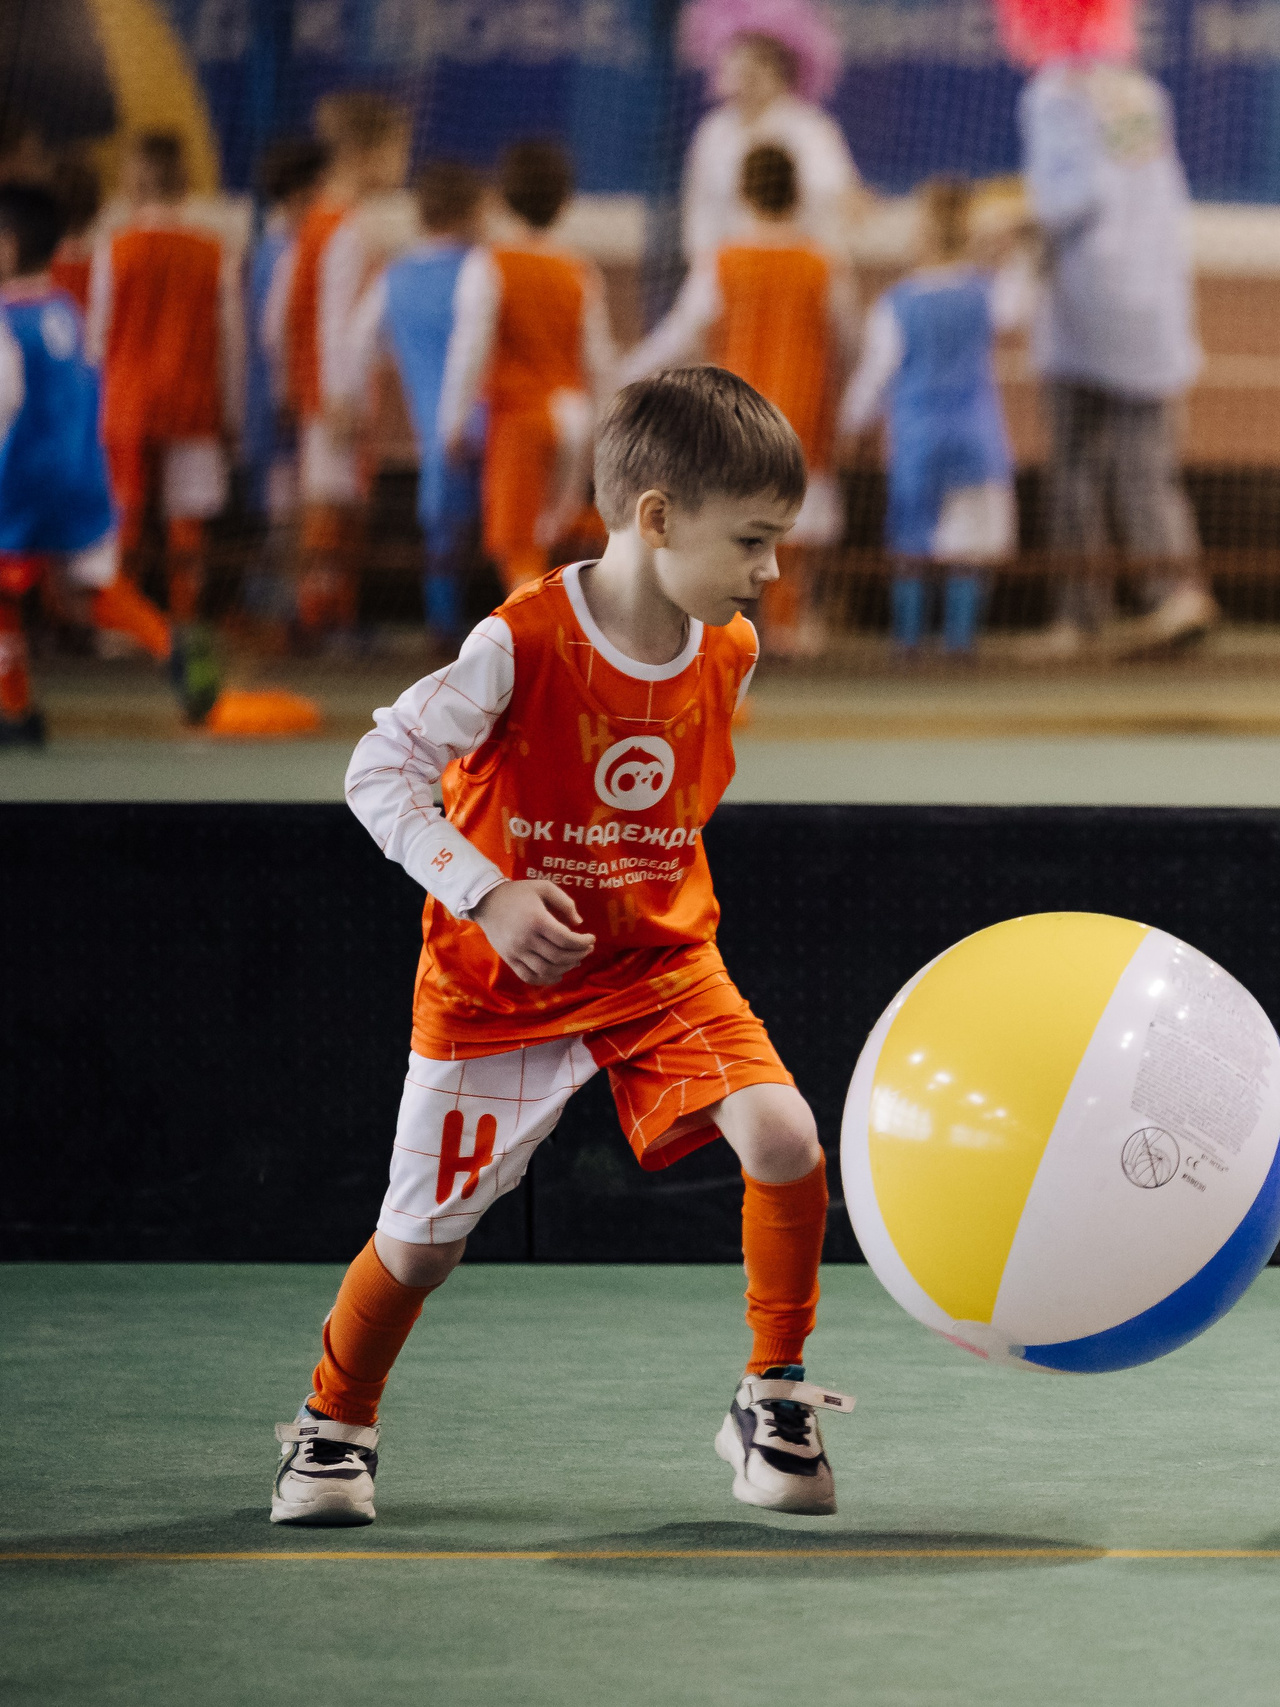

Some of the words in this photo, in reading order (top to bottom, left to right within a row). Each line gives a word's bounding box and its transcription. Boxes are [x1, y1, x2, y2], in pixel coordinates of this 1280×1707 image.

[508, 816, 555, 841] ФК
[430, 847, 454, 873] 35
[525, 866, 595, 889] ВМЕСТЕ
